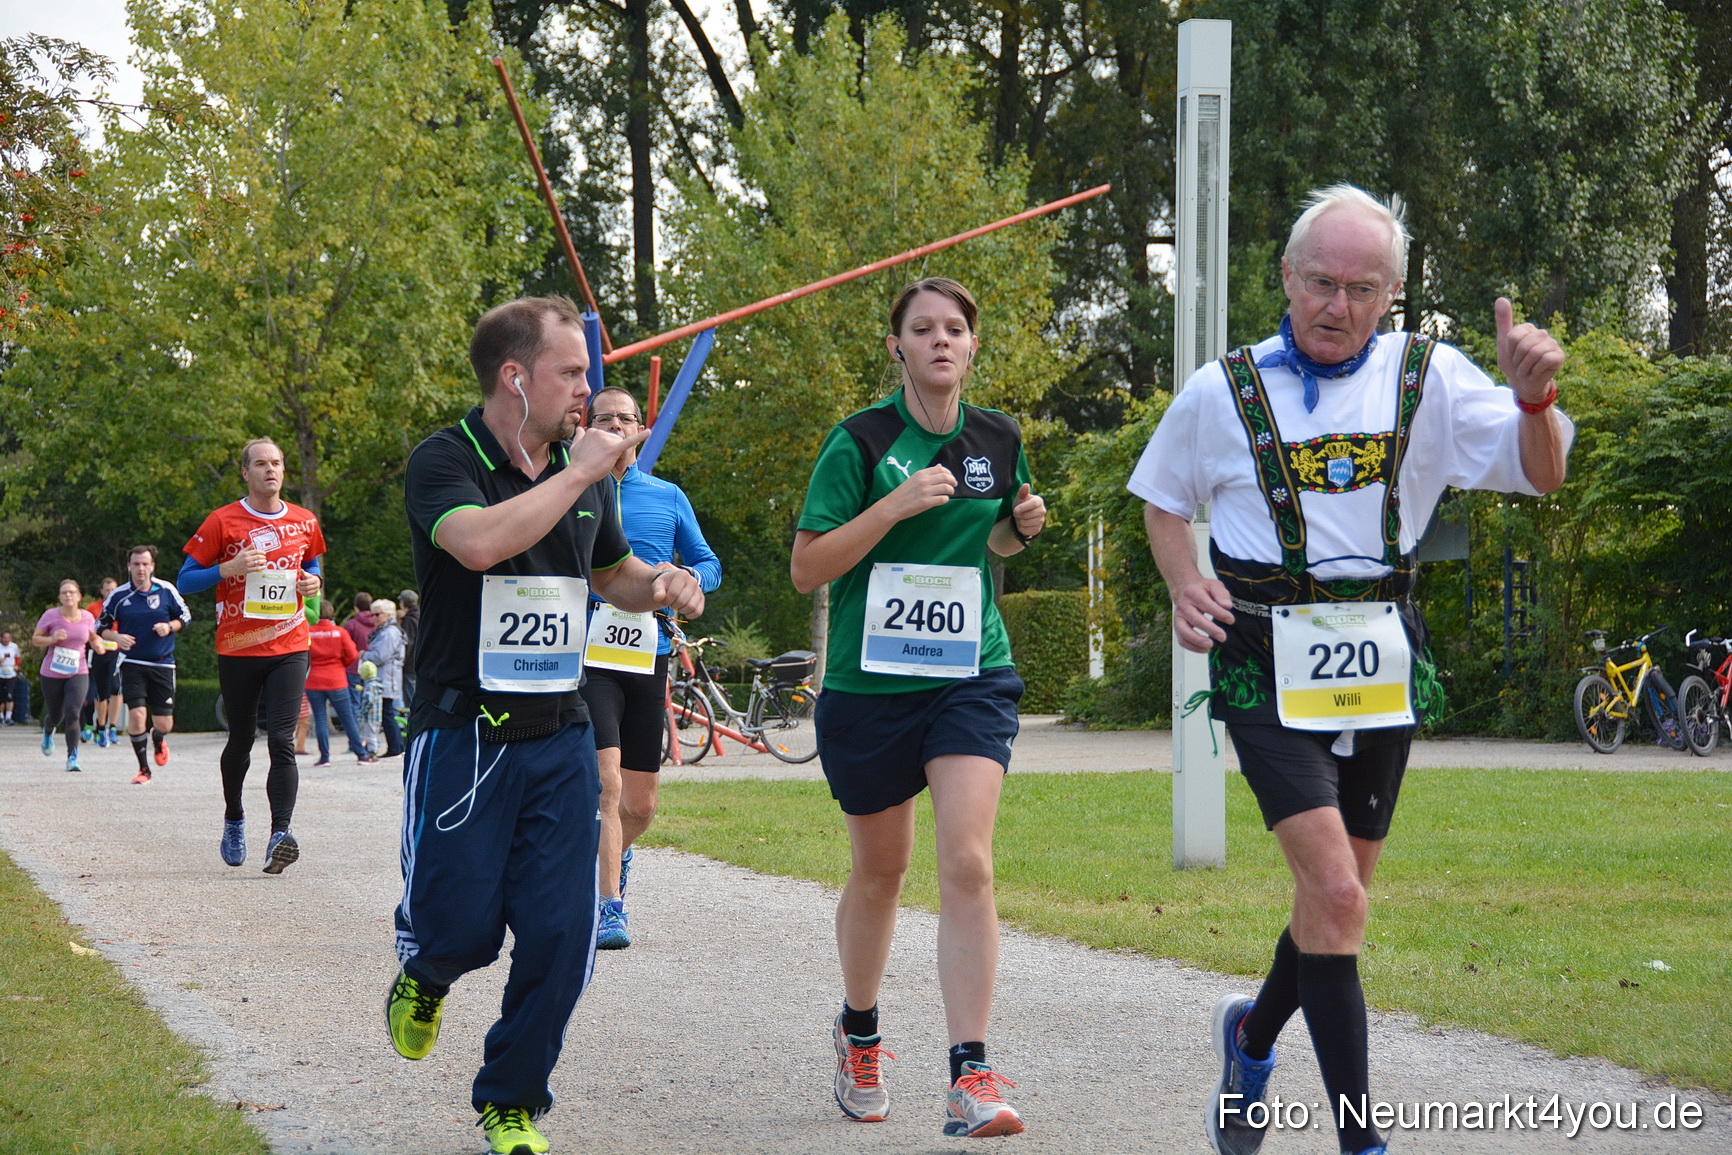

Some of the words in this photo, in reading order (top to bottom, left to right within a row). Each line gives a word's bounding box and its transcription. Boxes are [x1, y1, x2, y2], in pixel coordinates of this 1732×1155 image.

[915, 575, 952, 586] BOCK
[259, 585, 287, 600] 167
[530, 588, 560, 597] BOCK
[884, 598, 965, 634] 2460
[1325, 615, 1367, 626] BOCK
[499, 612, 569, 646] 2251
[604, 625, 642, 647] 302
[902, 643, 943, 657] Andrea
[514, 659, 558, 671] Christian
[1308, 640, 1380, 680] 220
[1333, 692, 1361, 706] Willi
